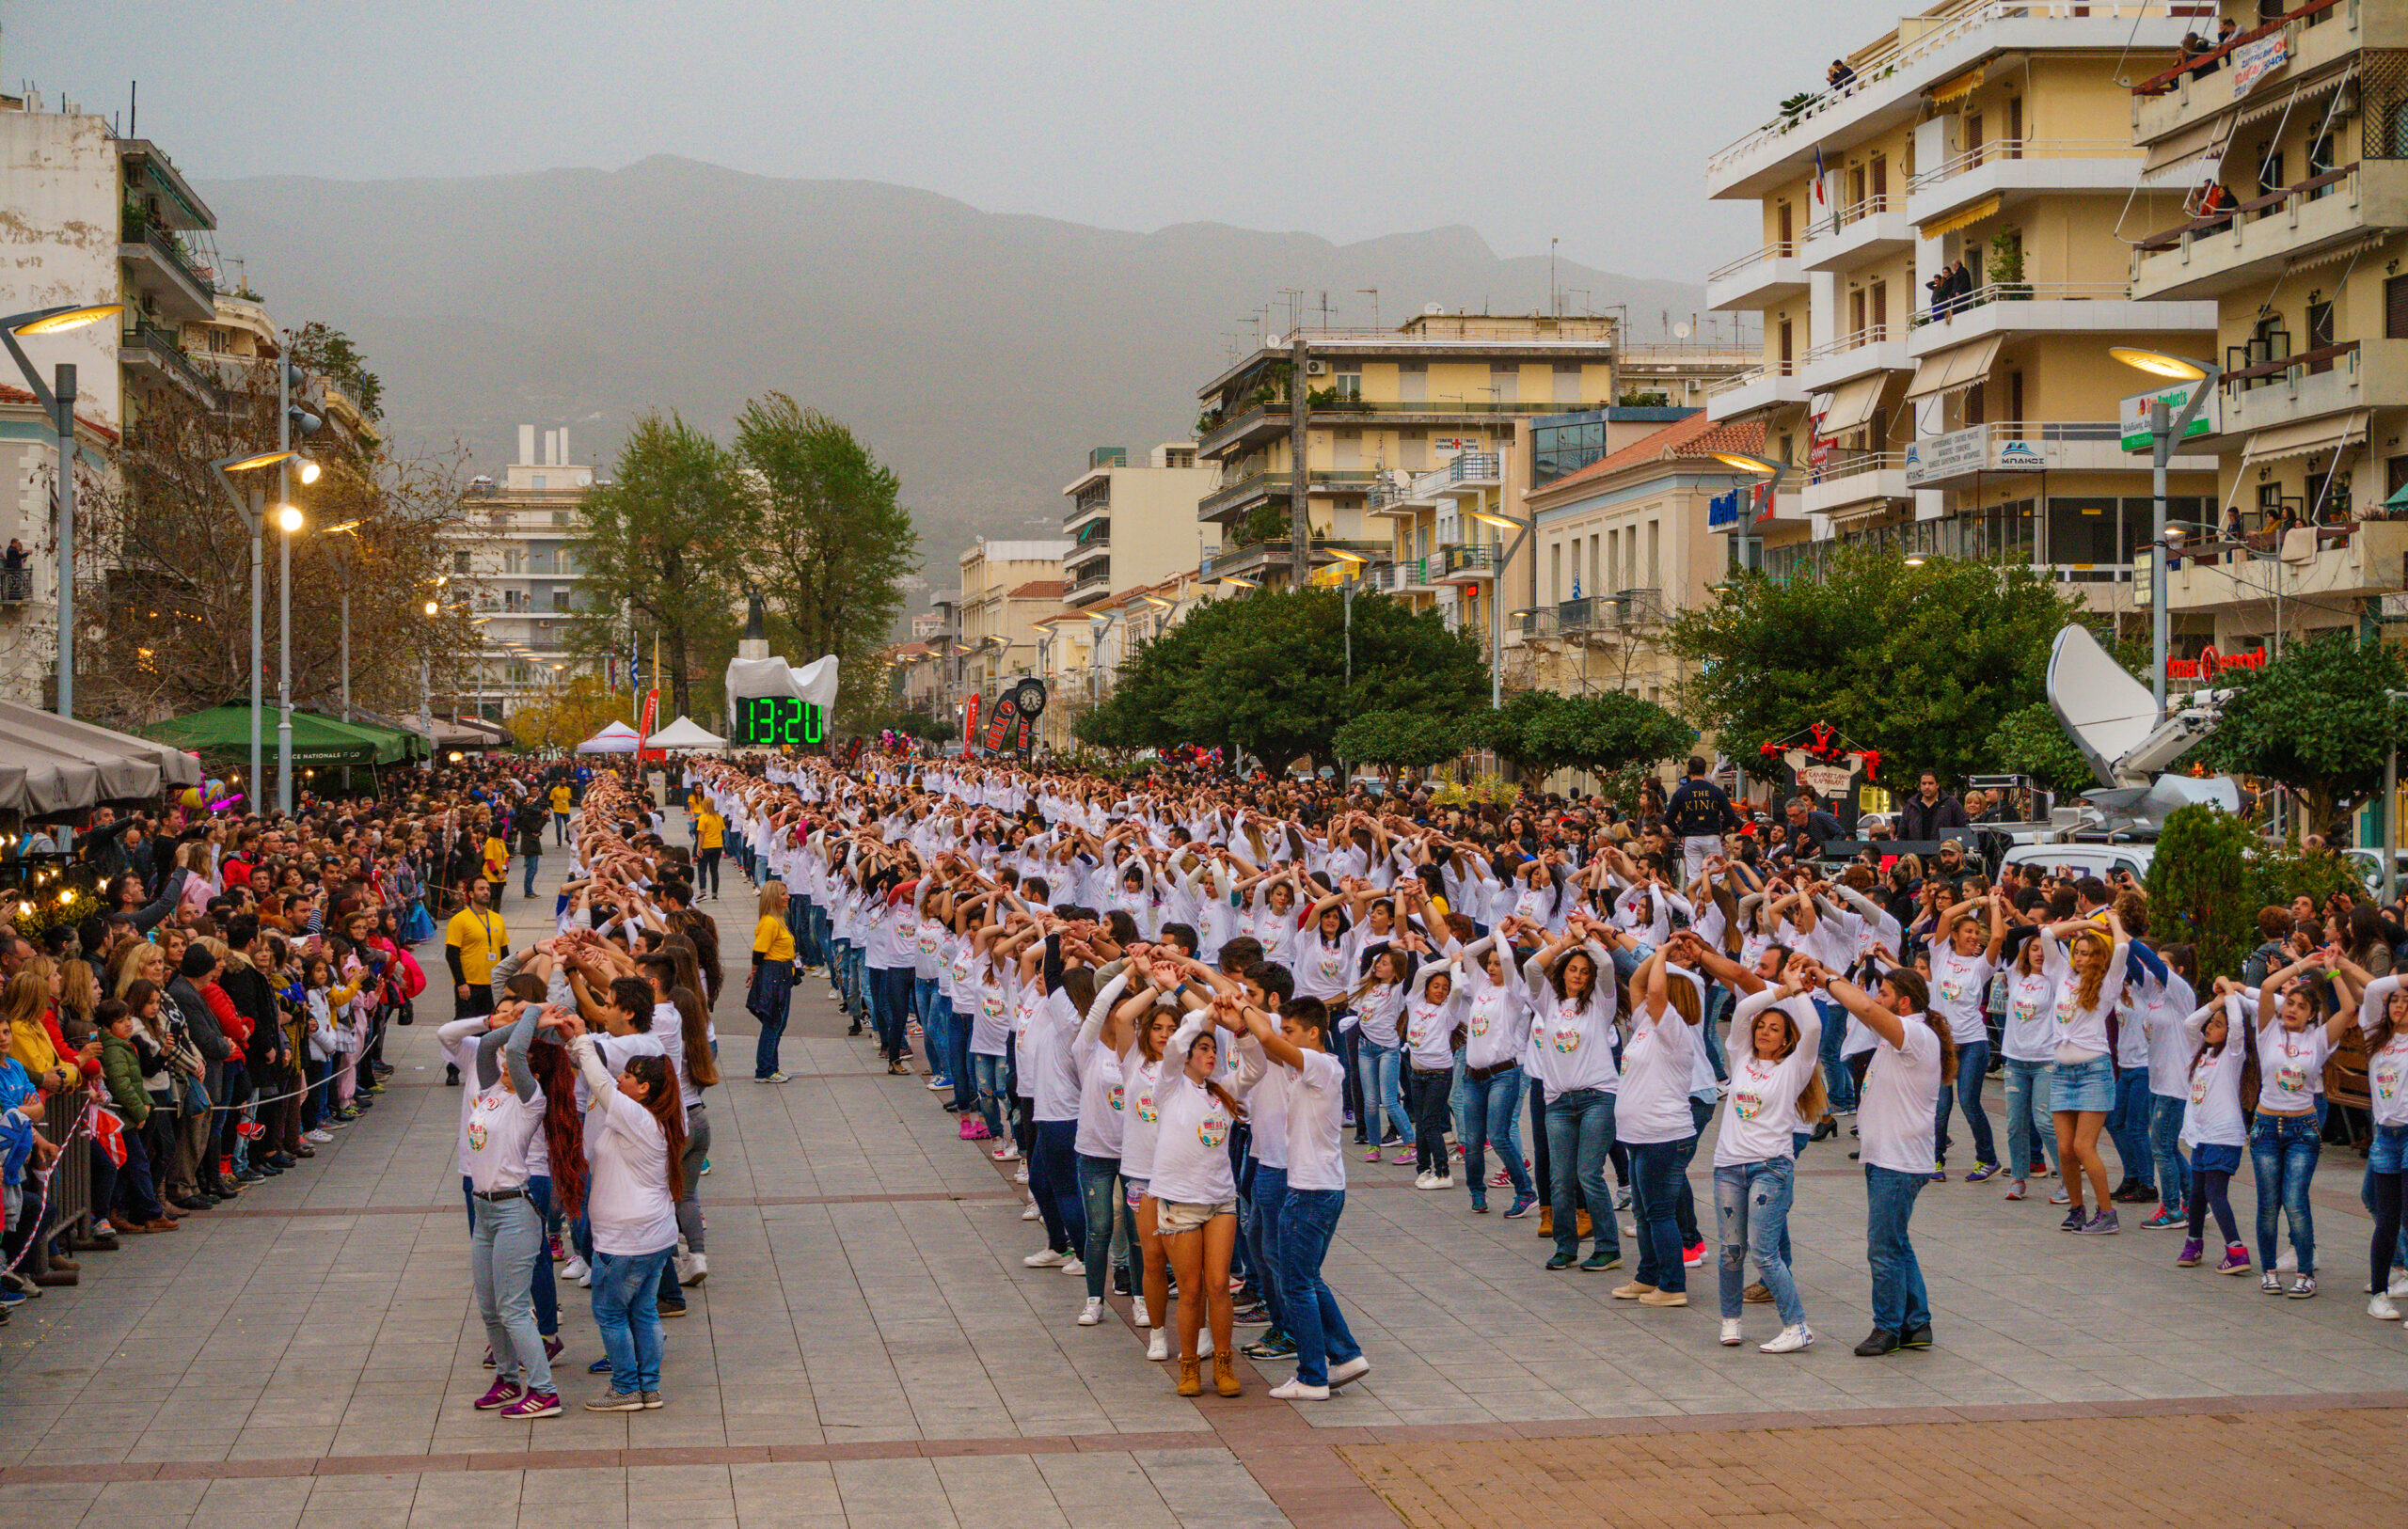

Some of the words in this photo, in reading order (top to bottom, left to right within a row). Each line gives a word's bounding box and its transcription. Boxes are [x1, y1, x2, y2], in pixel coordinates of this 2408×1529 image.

[2166, 654, 2198, 677] lma
[750, 699, 822, 743] 13:20
[986, 717, 1010, 750] HELL
